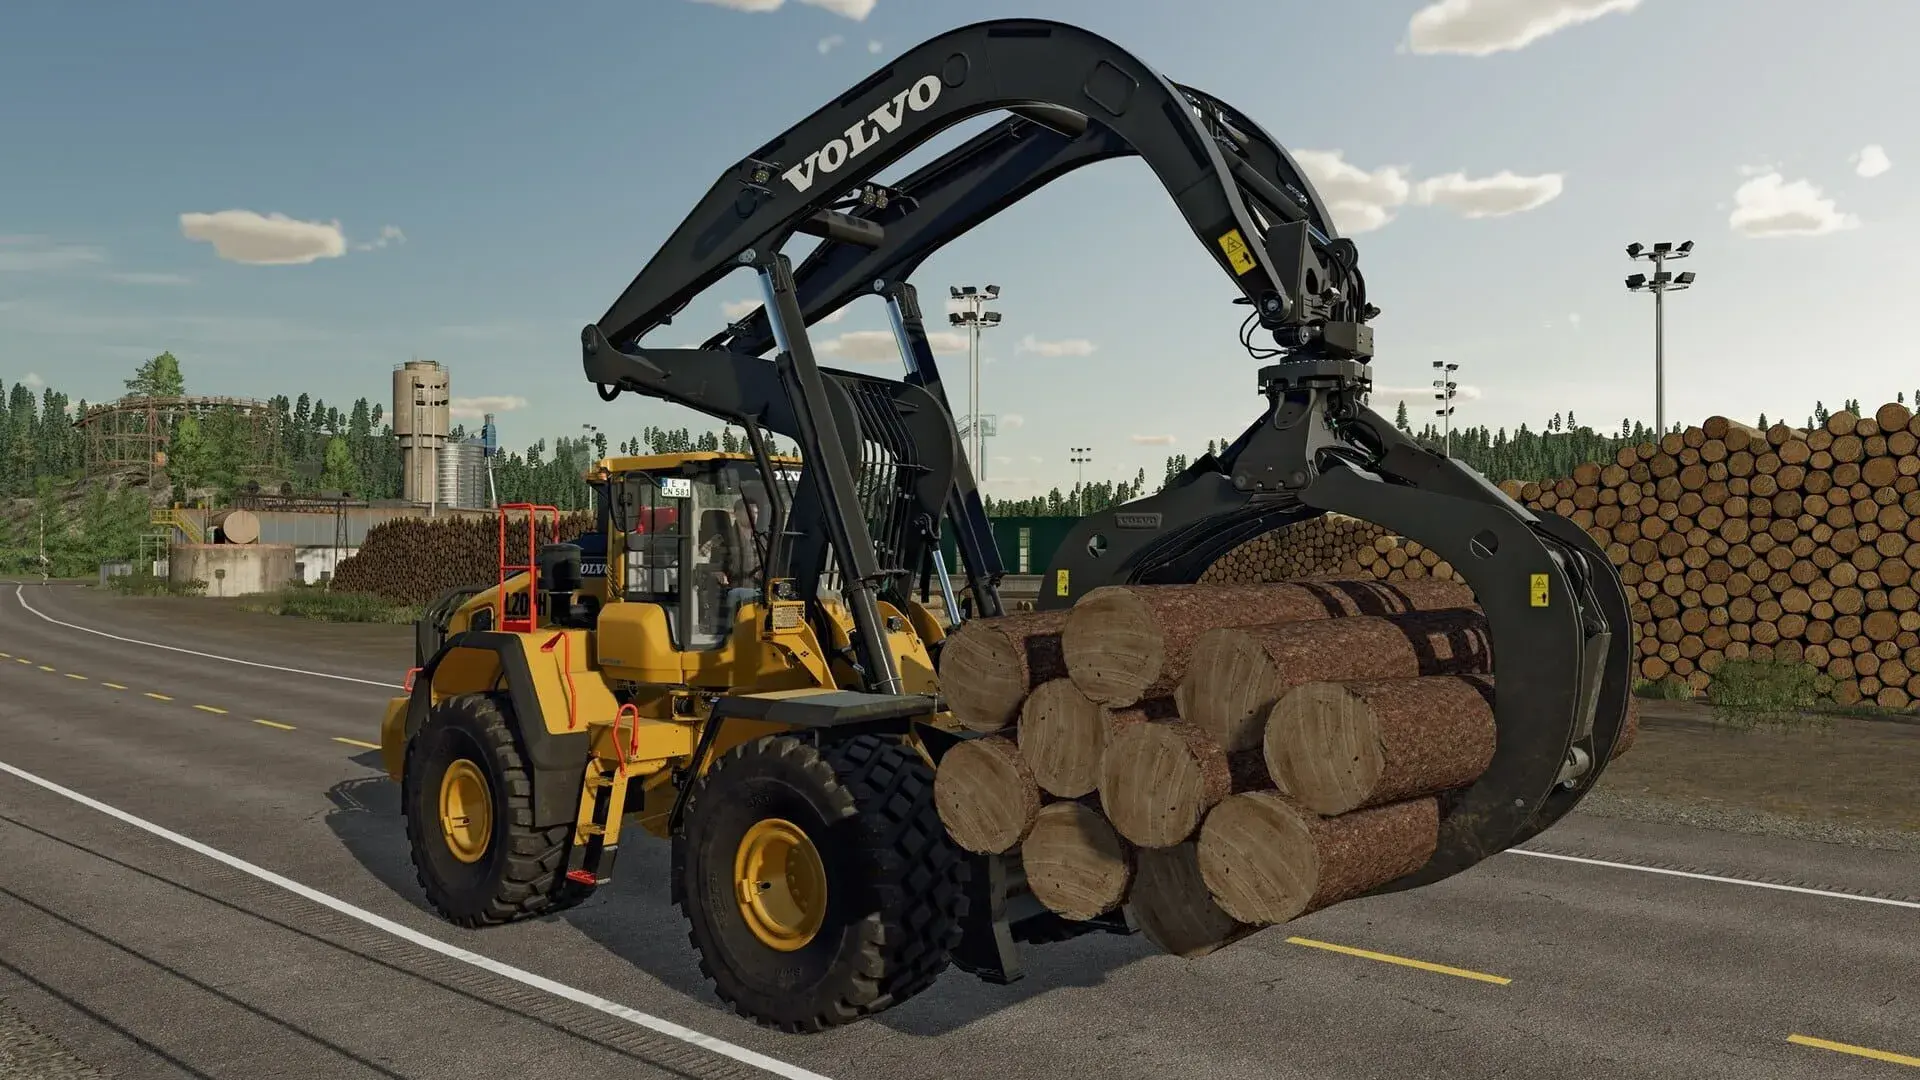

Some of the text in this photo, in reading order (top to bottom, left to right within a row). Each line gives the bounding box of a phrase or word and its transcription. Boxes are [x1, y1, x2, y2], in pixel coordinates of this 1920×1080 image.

[781, 75, 942, 193] VOLVO
[675, 488, 689, 496] 581
[580, 563, 610, 575] OLV
[504, 592, 547, 617] L20H
